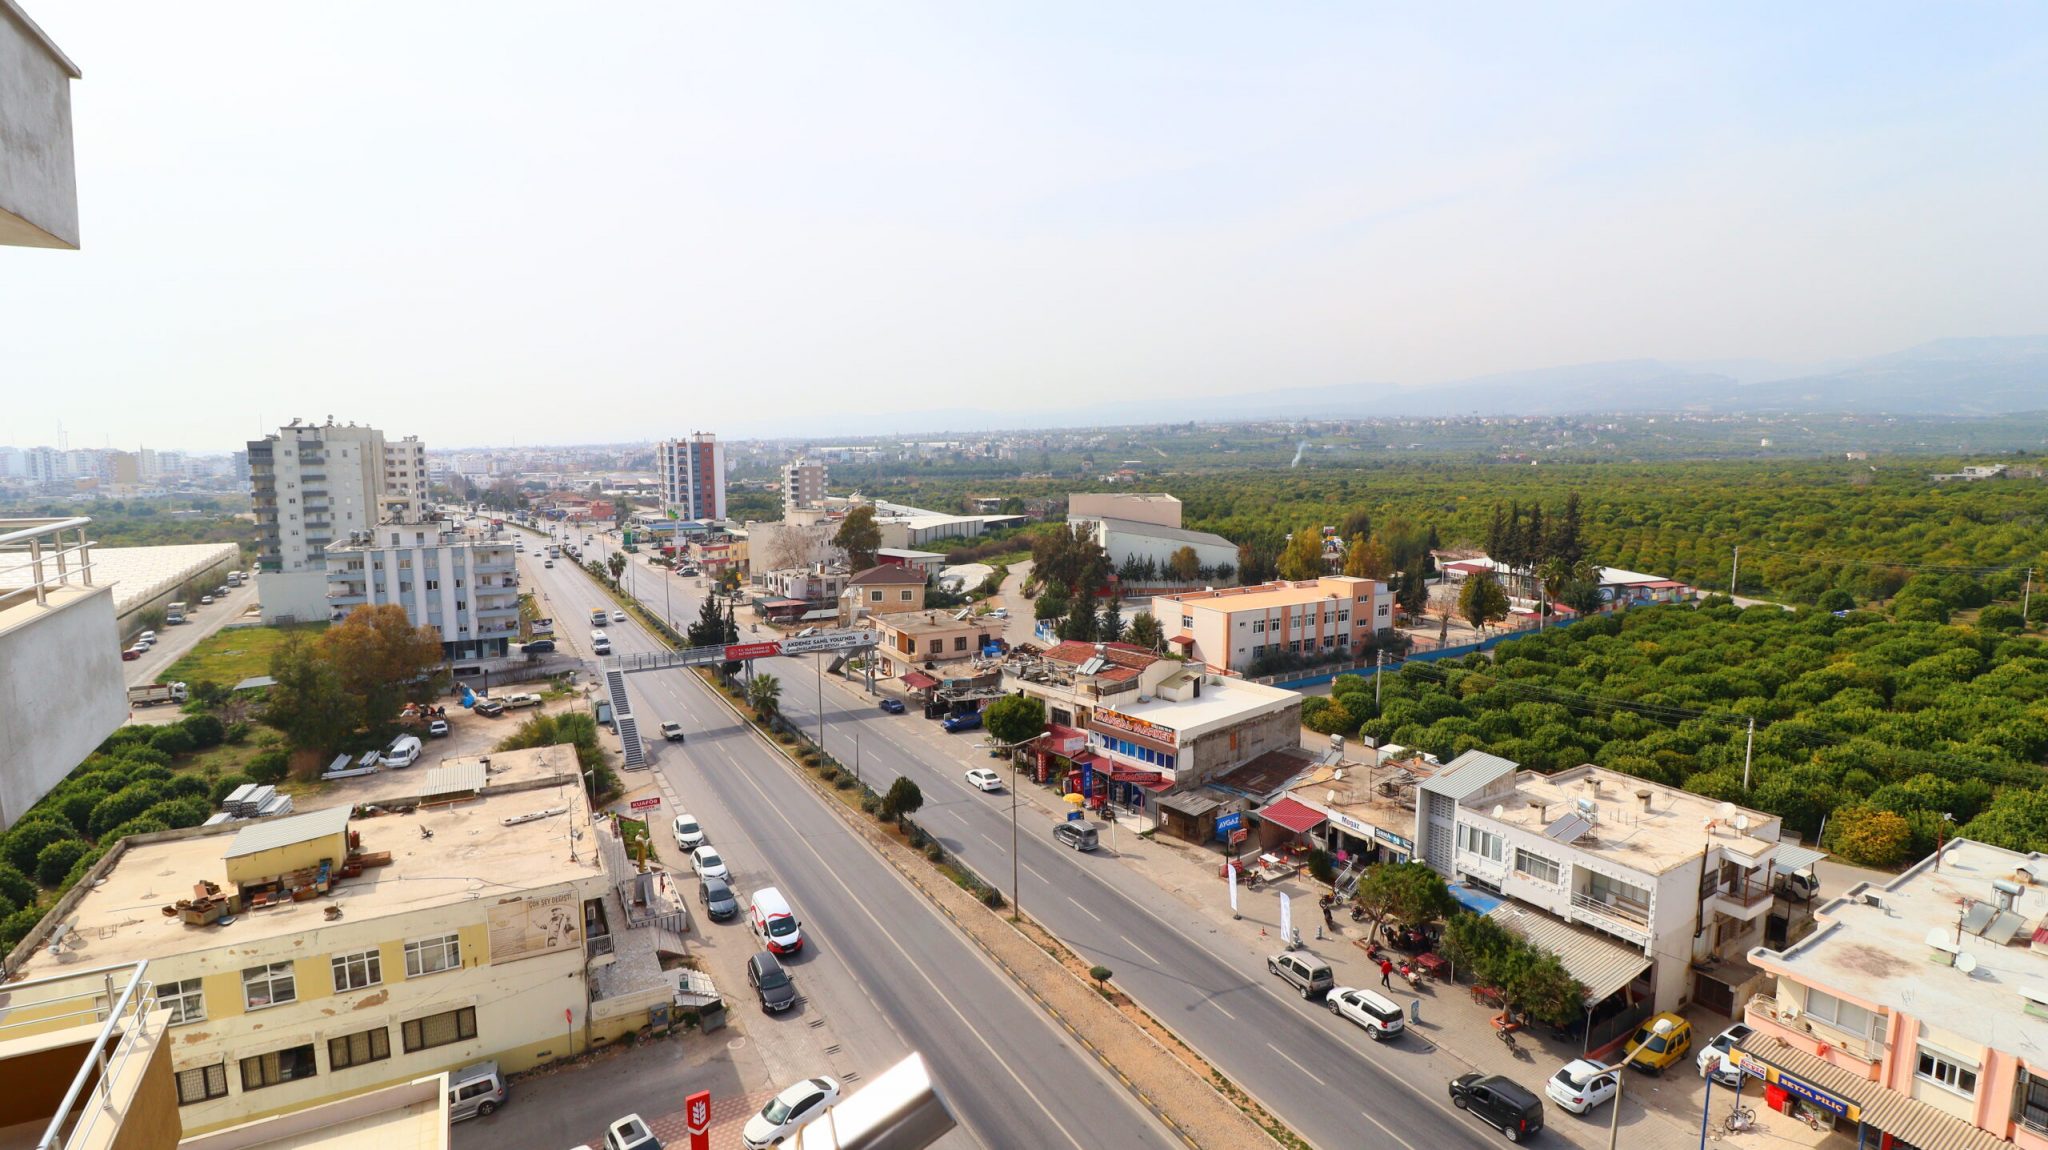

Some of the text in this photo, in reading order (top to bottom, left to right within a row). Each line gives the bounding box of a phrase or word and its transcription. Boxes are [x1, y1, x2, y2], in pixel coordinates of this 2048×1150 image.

[787, 640, 811, 648] AKDENİZ
[813, 637, 829, 645] SAHİL
[1095, 711, 1133, 731] MANGAL
[1133, 723, 1172, 743] MARKET
[1218, 817, 1239, 830] AYGAZ
[1342, 816, 1360, 830] Mogaz
[1781, 1077, 1844, 1113] BEYZA PİLİÇ
